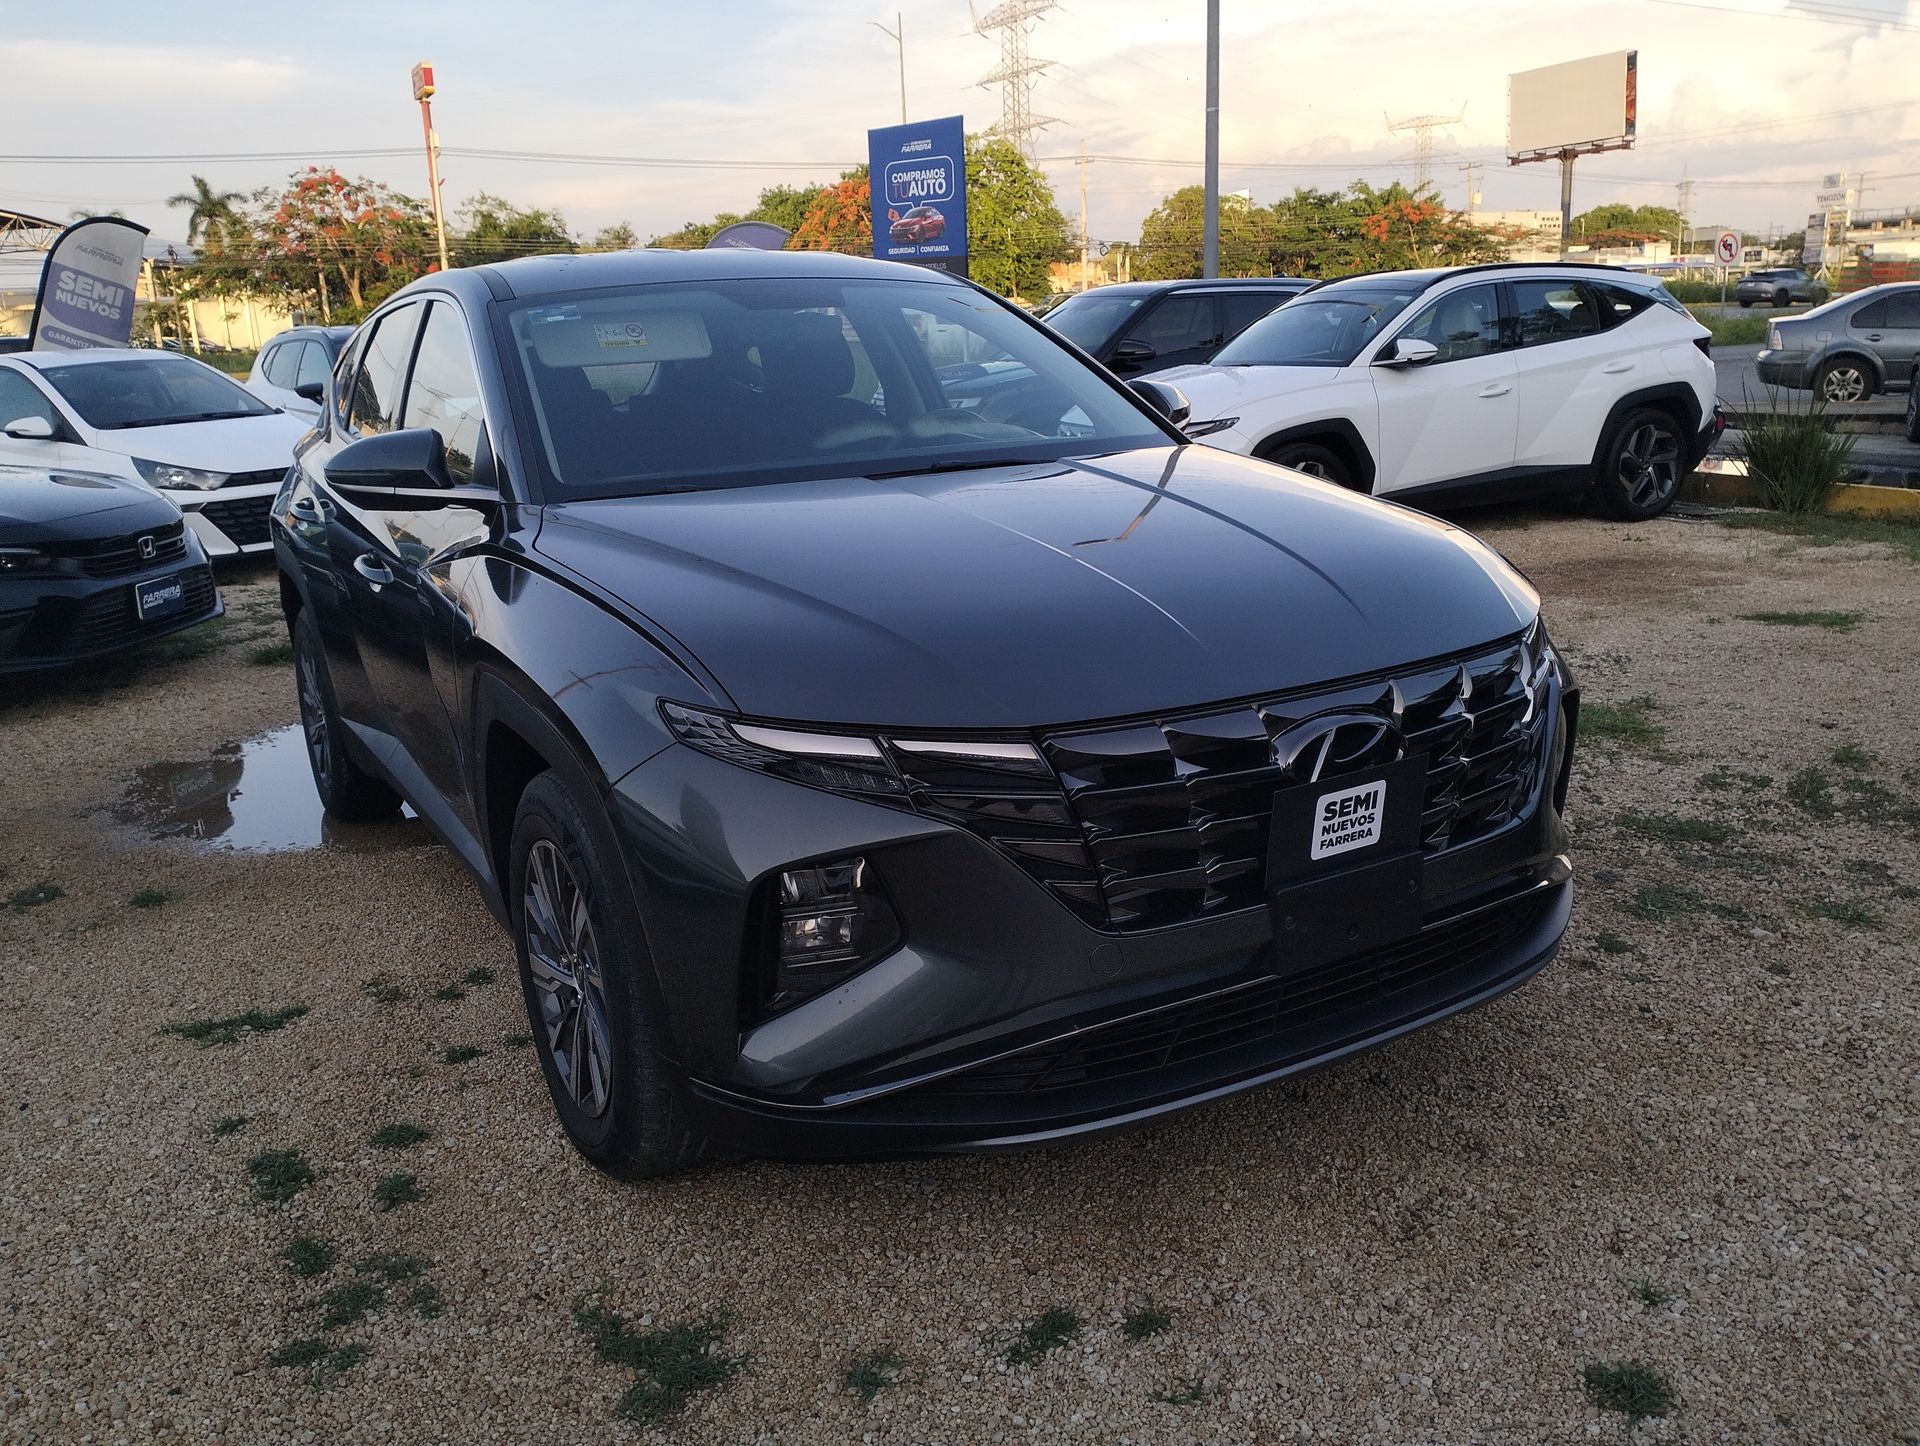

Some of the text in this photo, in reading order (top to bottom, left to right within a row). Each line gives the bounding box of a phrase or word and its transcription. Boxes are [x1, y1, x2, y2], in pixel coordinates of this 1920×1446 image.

[891, 168, 946, 183] COMPRAMOS
[888, 245, 949, 255] SEGURIDAD CONFIANZA
[58, 270, 125, 307] SEMI
[55, 289, 121, 320] NUEVOS
[142, 584, 180, 604] FARRERA
[1322, 789, 1379, 822] SEMI
[1321, 812, 1375, 836] NUEVOS
[1319, 827, 1373, 851] FARRERA
